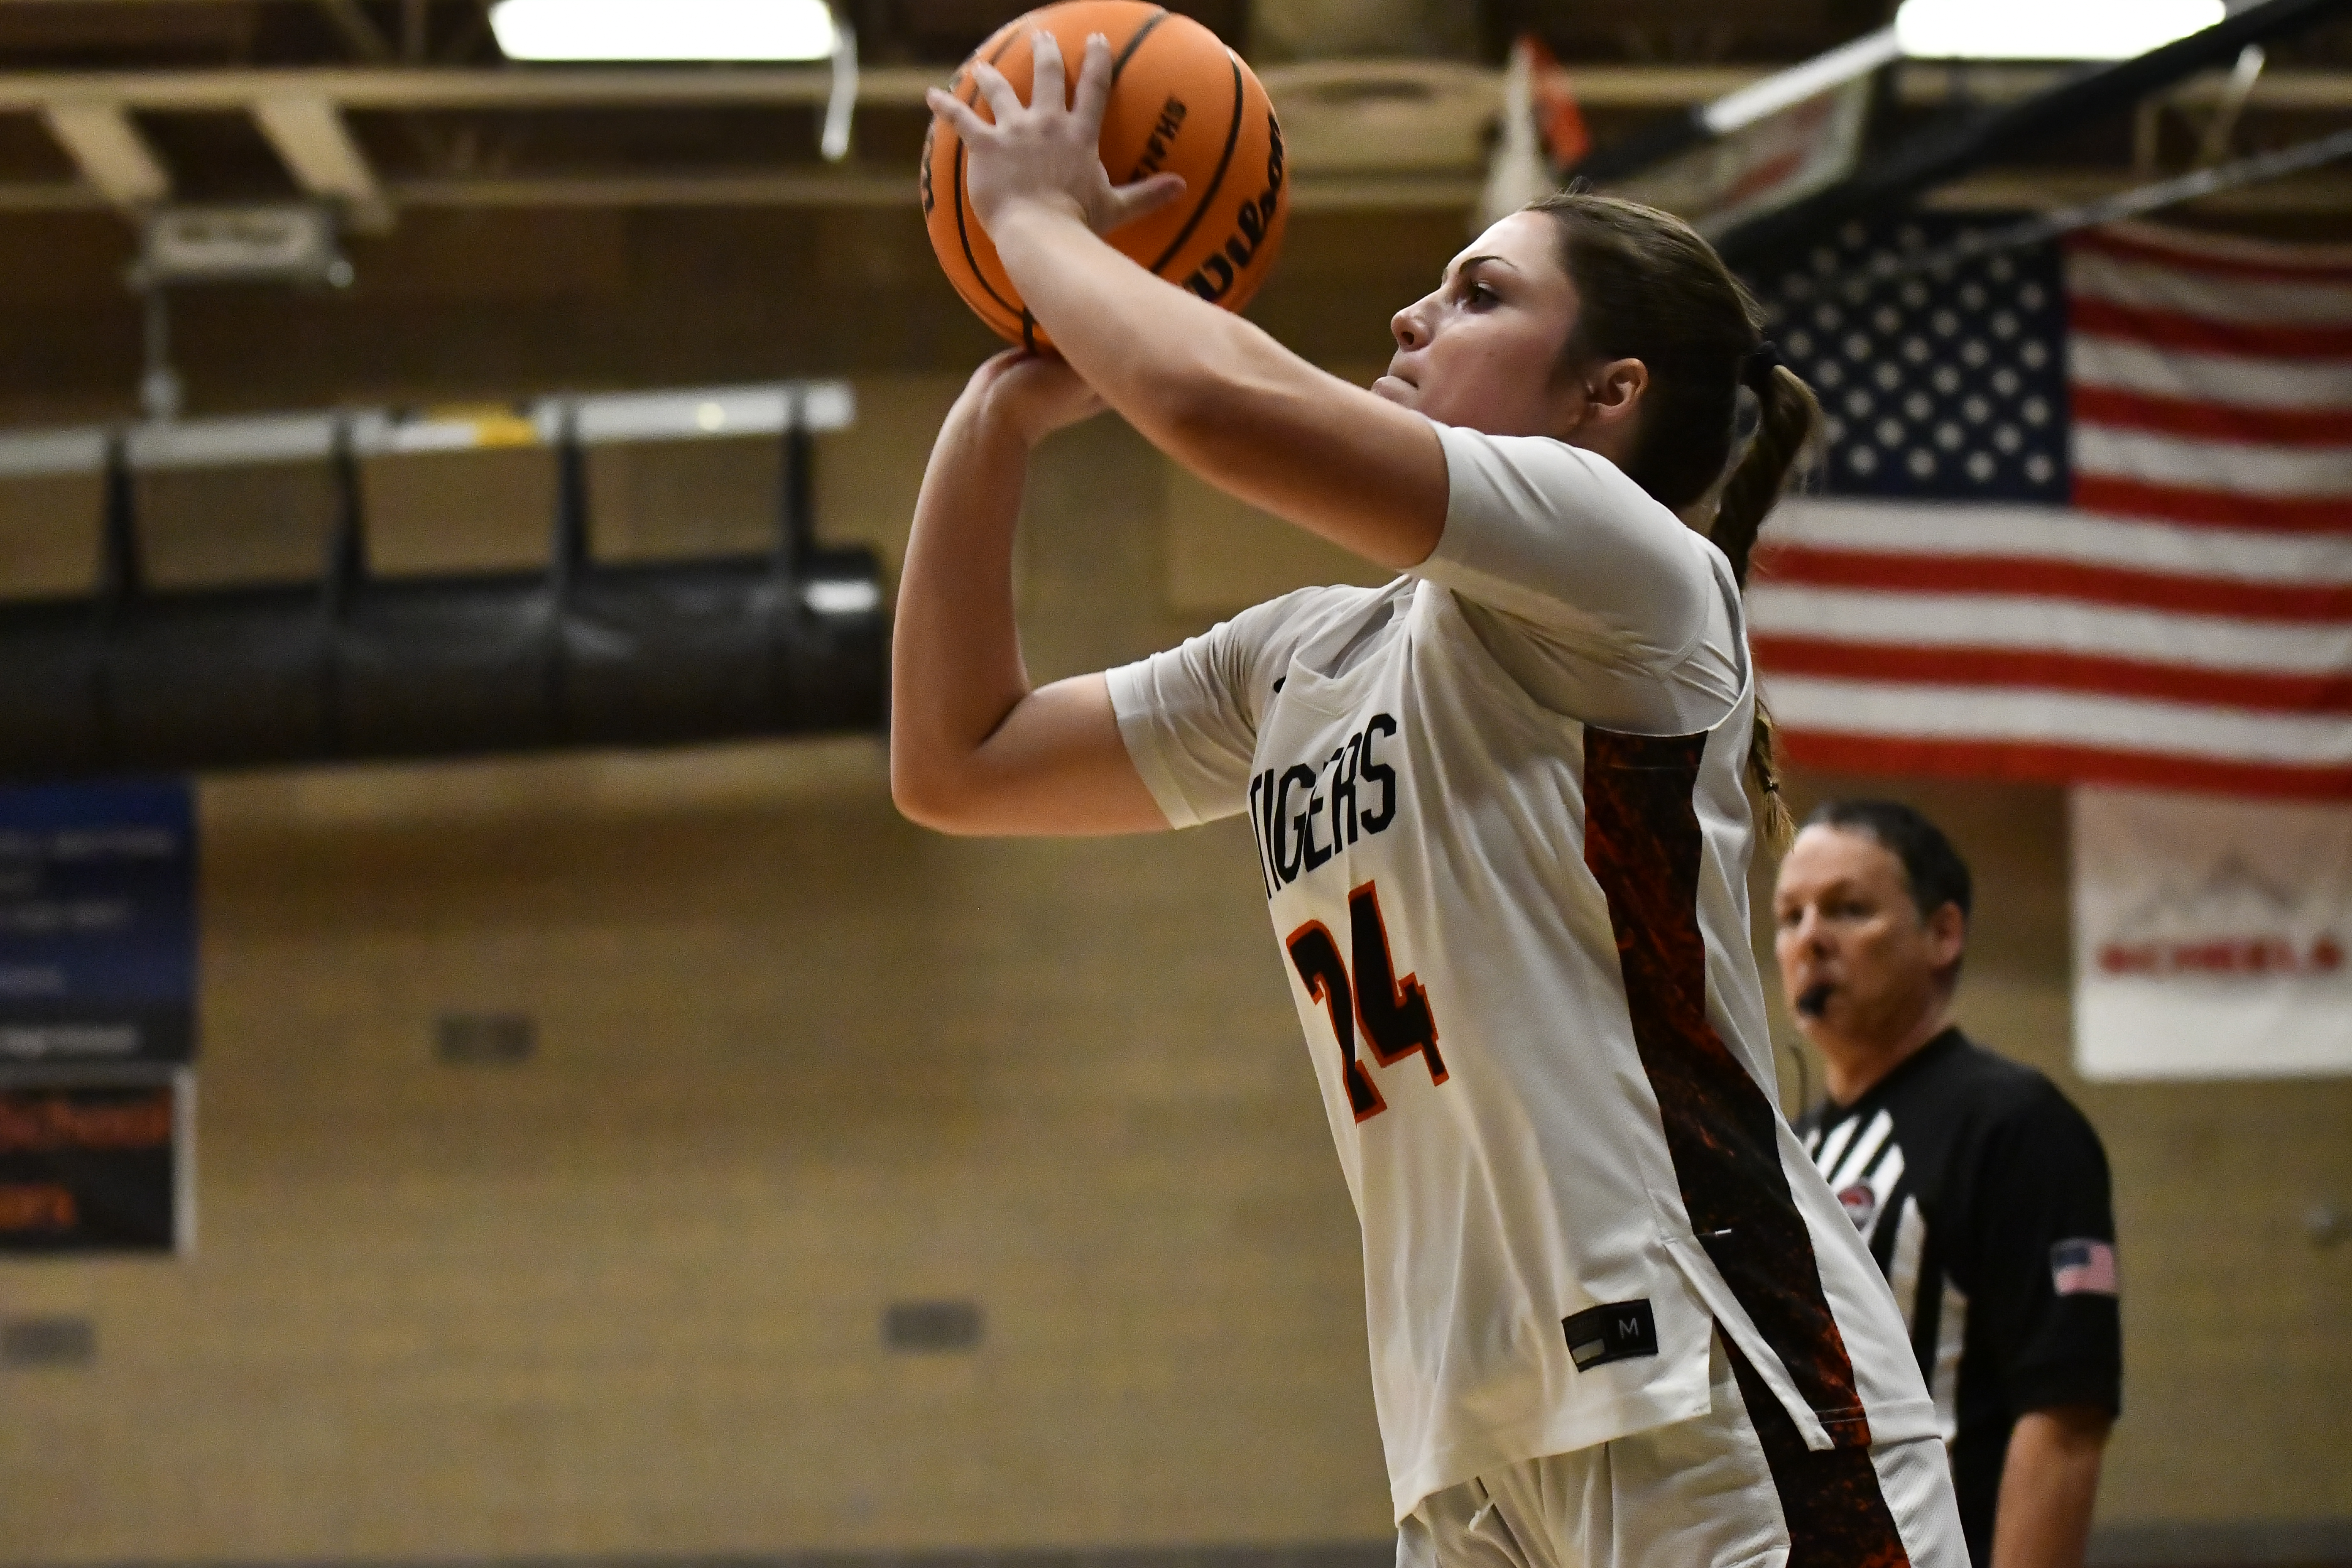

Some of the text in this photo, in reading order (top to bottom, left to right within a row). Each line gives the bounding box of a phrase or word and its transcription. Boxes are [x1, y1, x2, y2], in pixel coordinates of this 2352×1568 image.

[1250, 713, 1396, 898] TIGERS
[1286, 880, 1450, 1127] 24
[1619, 1318, 1639, 1339] M
